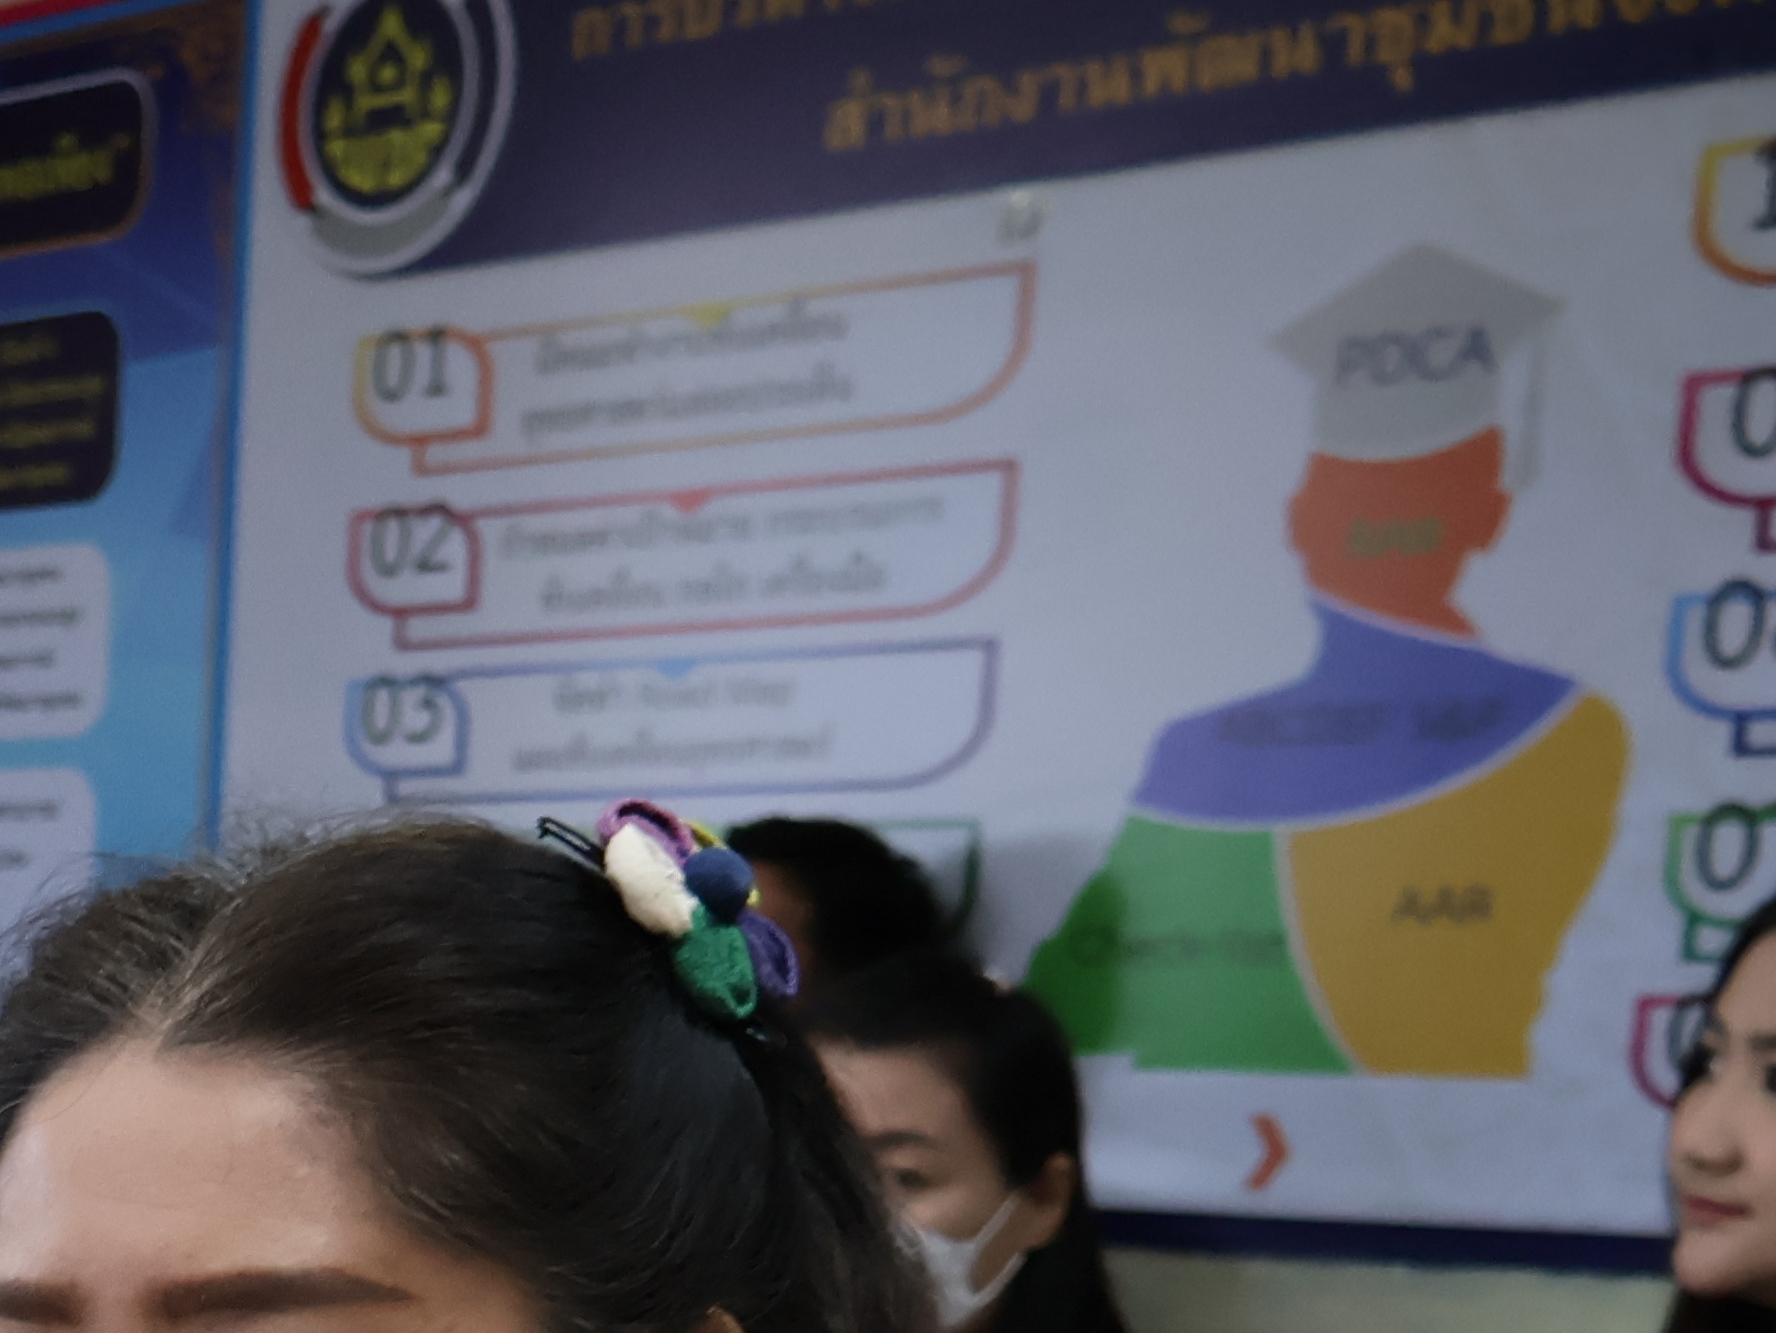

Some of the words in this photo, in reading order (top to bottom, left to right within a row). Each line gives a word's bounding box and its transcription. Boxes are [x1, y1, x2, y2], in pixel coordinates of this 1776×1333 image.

[373, 325, 451, 402] 01
[1333, 323, 1496, 388] PDCA
[370, 500, 453, 577] 02
[362, 674, 442, 745] 03
